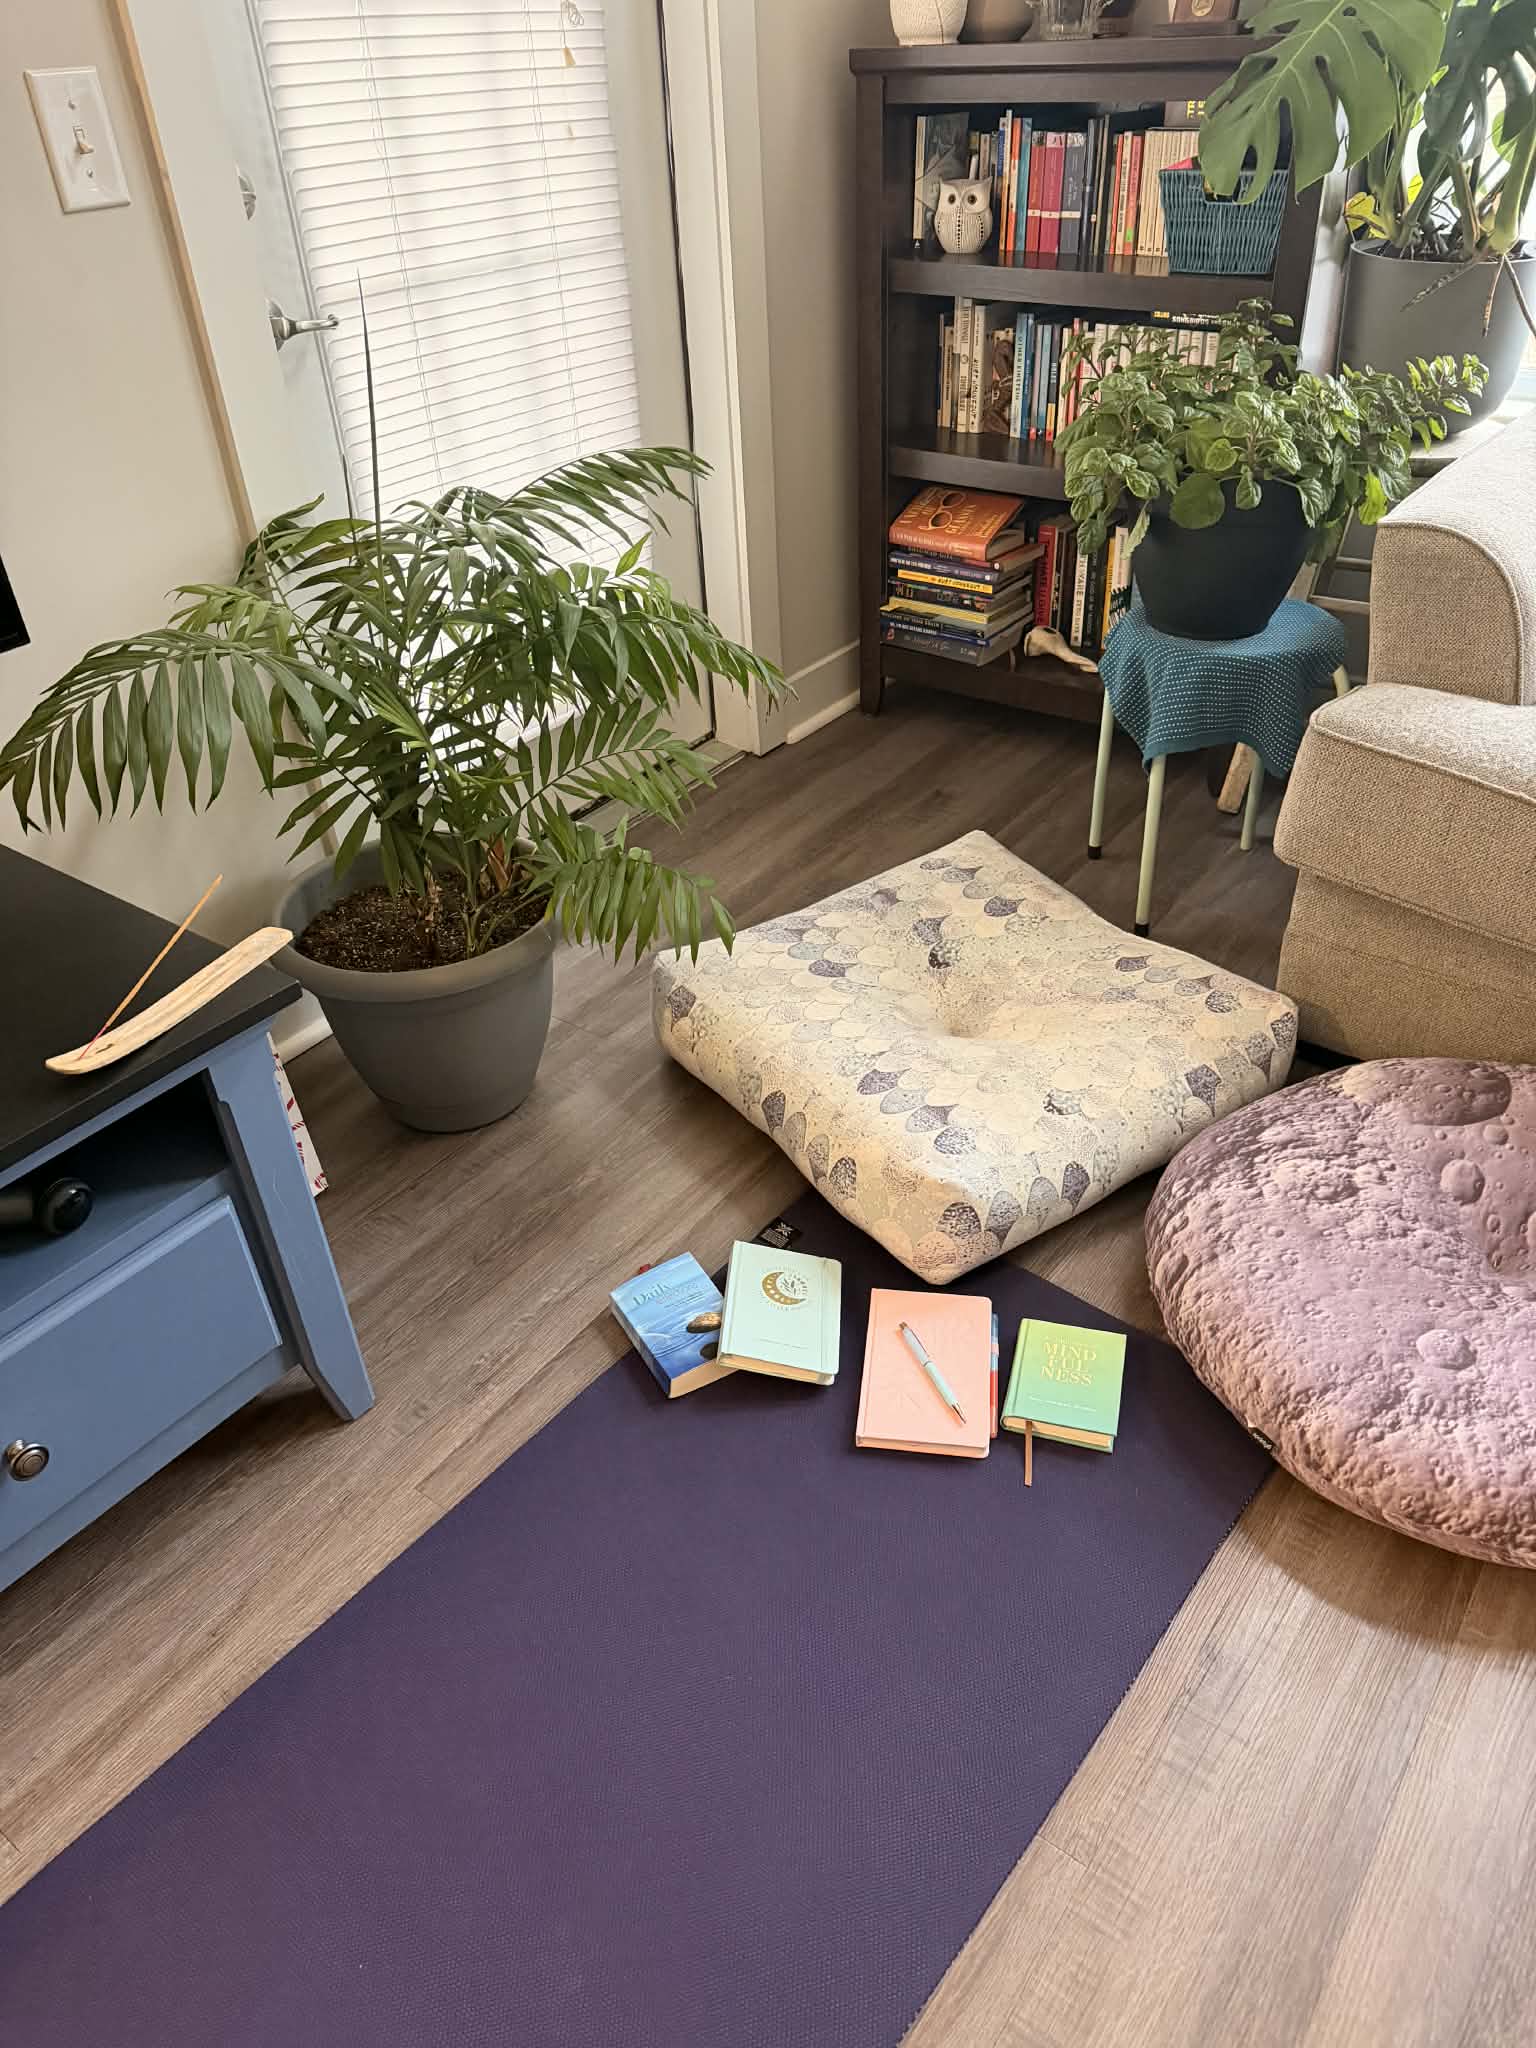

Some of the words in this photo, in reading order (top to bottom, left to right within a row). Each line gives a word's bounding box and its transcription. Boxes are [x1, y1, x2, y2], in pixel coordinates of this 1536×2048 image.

[633, 1281, 672, 1307] Daily
[1043, 1342, 1097, 1361] MIND
[1048, 1355, 1089, 1372] FUL
[1040, 1366, 1093, 1386] NESS
